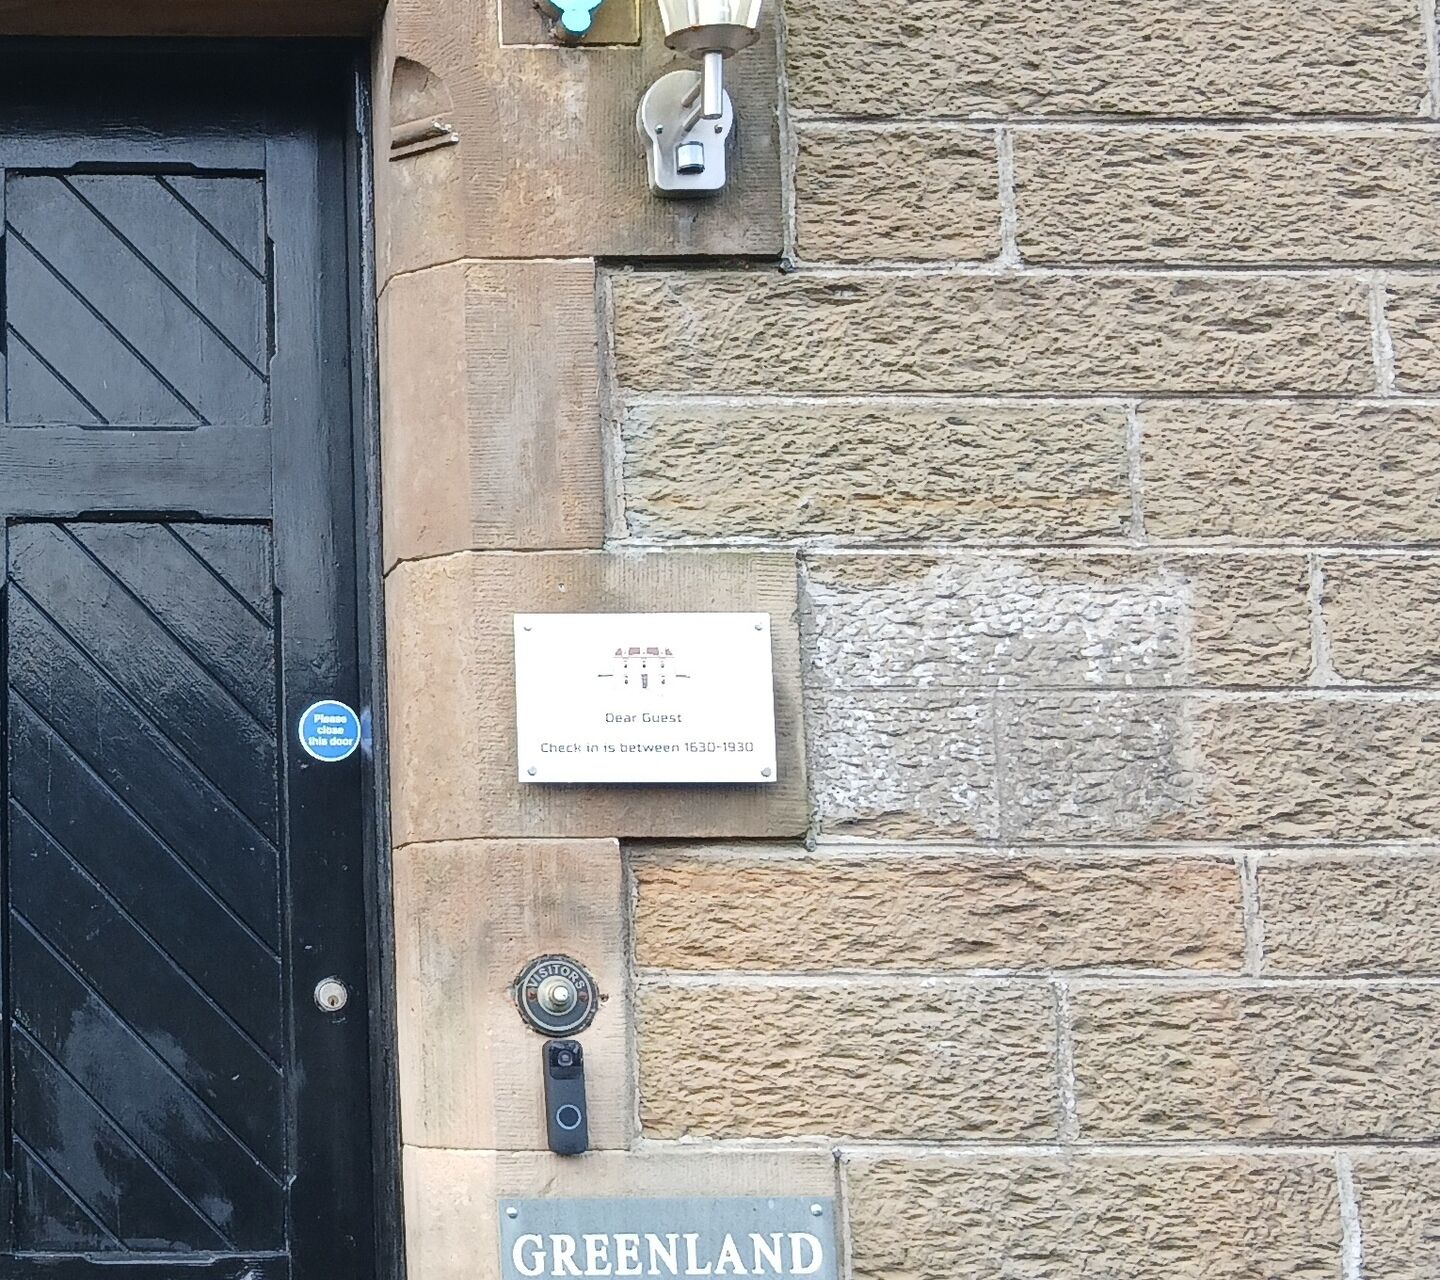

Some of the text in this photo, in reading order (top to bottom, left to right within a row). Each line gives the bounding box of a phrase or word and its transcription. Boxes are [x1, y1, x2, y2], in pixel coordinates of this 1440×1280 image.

[313, 714, 347, 723] Please
[605, 713, 682, 723] Dear Guest
[330, 736, 353, 746] door
[540, 742, 754, 753] Check in is between 1630-1930
[527, 964, 585, 989] VISITORS
[512, 1232, 823, 1276] GREENLAND
